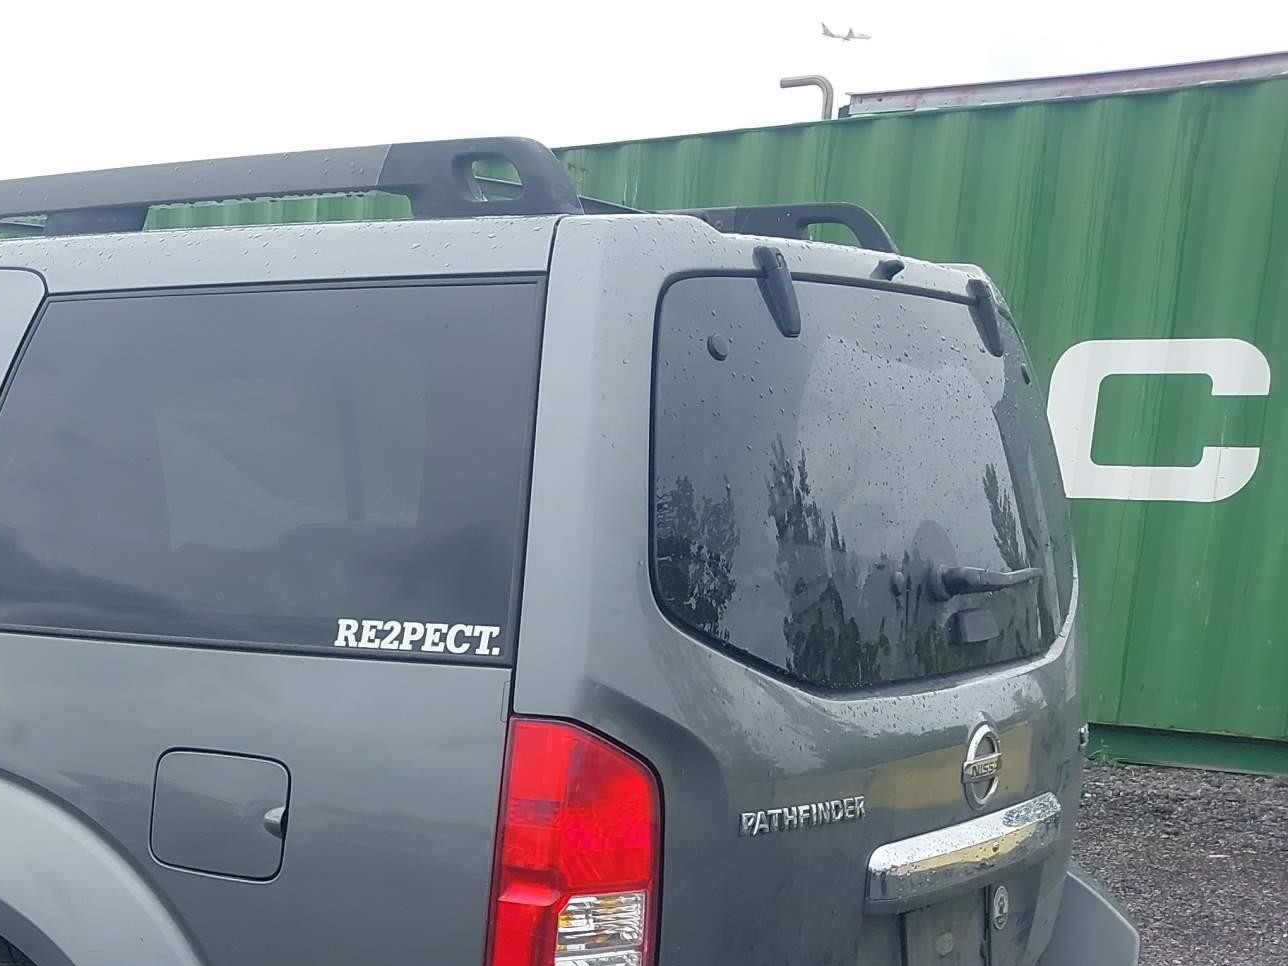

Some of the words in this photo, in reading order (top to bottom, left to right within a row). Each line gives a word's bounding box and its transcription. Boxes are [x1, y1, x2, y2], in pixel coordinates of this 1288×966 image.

[1047, 338, 1271, 502] C
[334, 618, 500, 656] RE2PECT.
[739, 796, 866, 836] PATHFINDER
